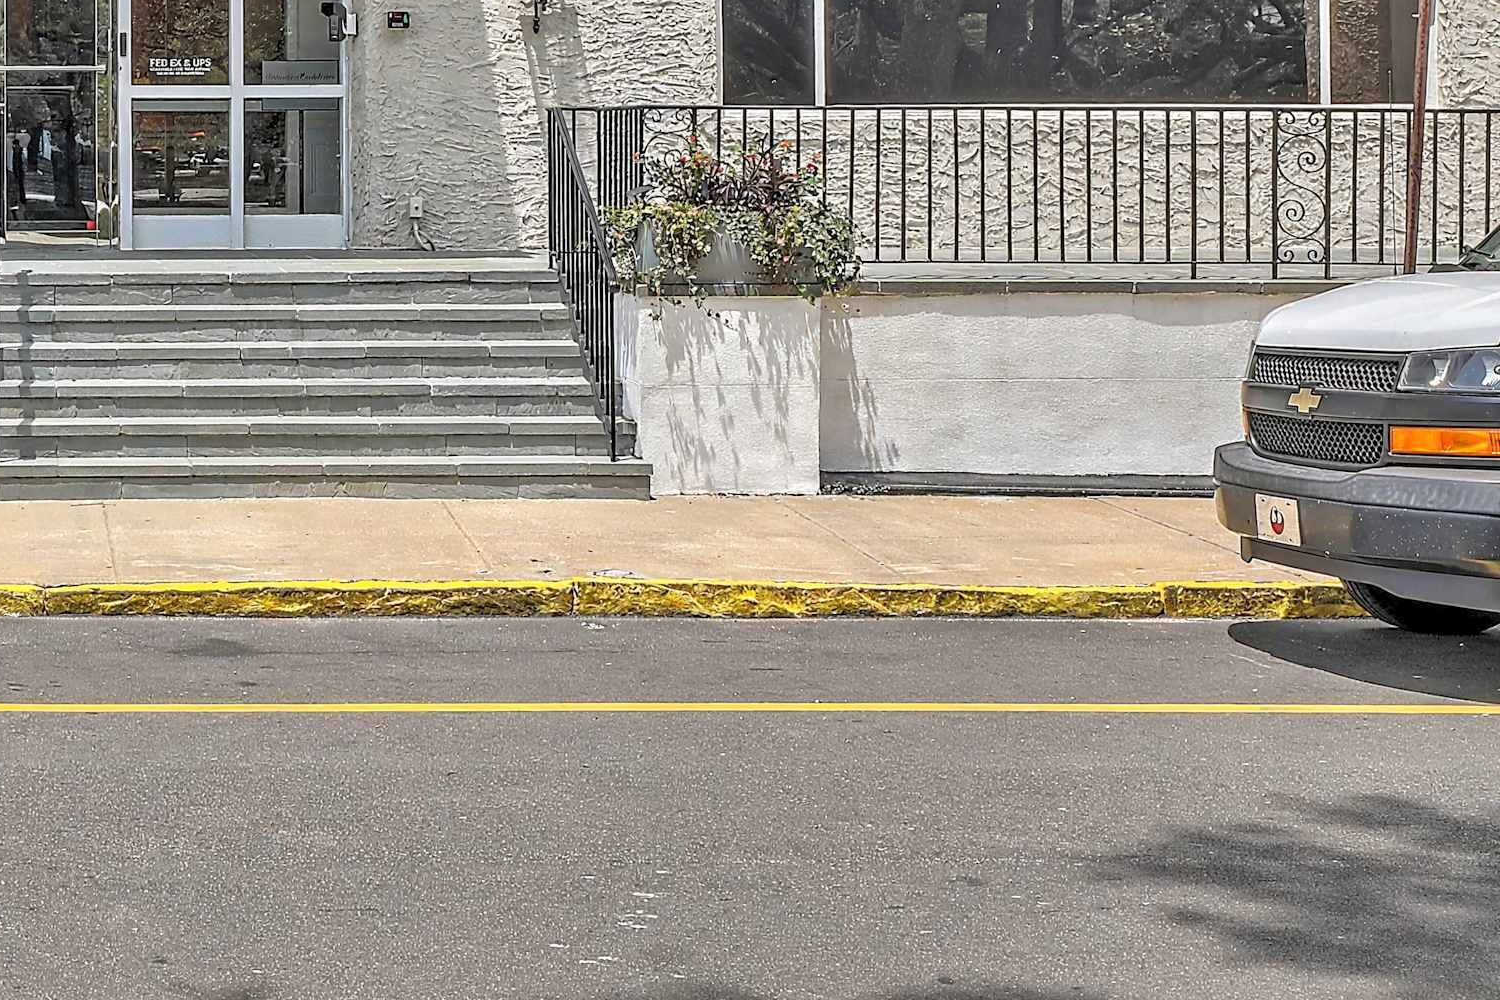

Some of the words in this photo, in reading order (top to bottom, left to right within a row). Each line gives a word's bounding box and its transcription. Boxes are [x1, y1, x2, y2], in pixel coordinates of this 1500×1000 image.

[149, 58, 168, 68] FED
[169, 58, 182, 67] EX
[183, 58, 191, 67] &
[192, 57, 212, 67] UPS
